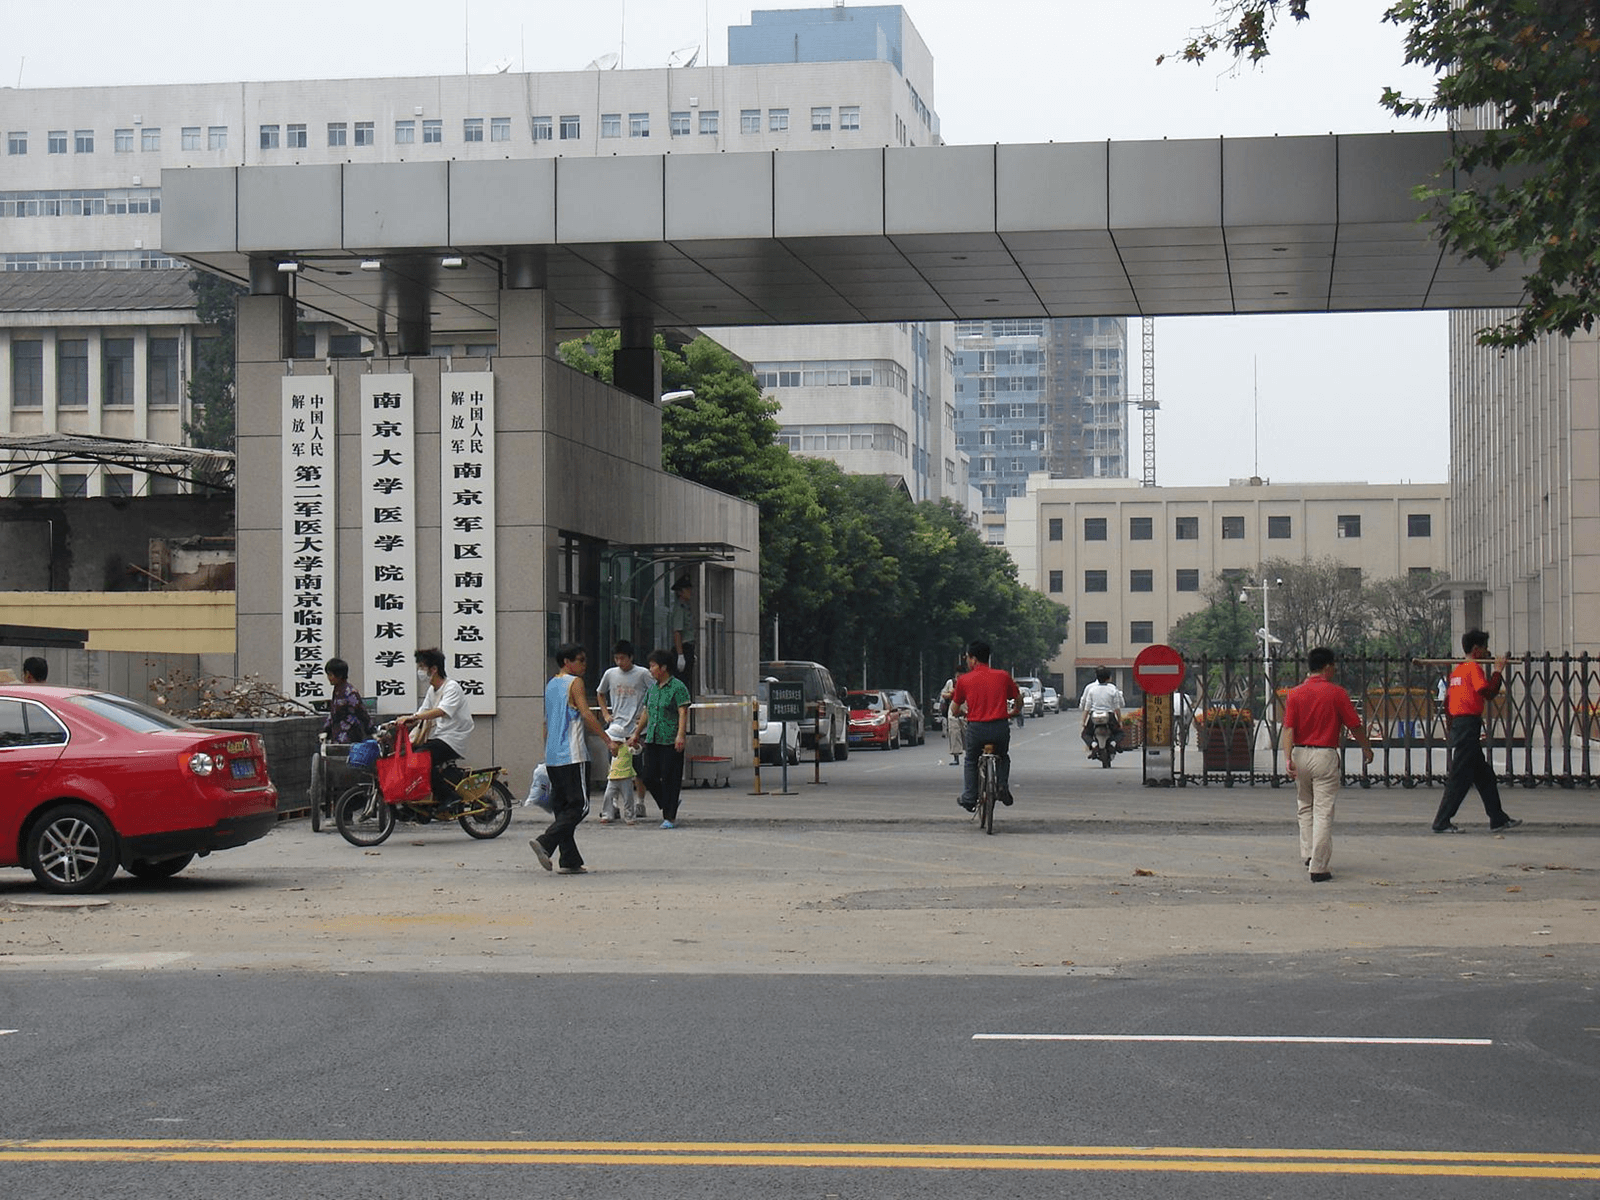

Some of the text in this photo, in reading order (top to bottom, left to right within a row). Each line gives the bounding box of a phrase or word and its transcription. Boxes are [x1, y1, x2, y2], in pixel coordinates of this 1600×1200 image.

[291, 394, 305, 457] 解放军
[310, 394, 324, 457] 中国人民
[450, 390, 465, 454] 解放军
[470, 390, 484, 454] 中国人民
[372, 392, 406, 697] 南京大学医学院临床学院
[293, 465, 324, 698] 第二军医大学南京临床医学院
[452, 463, 485, 696] 南京军区南京总医院
